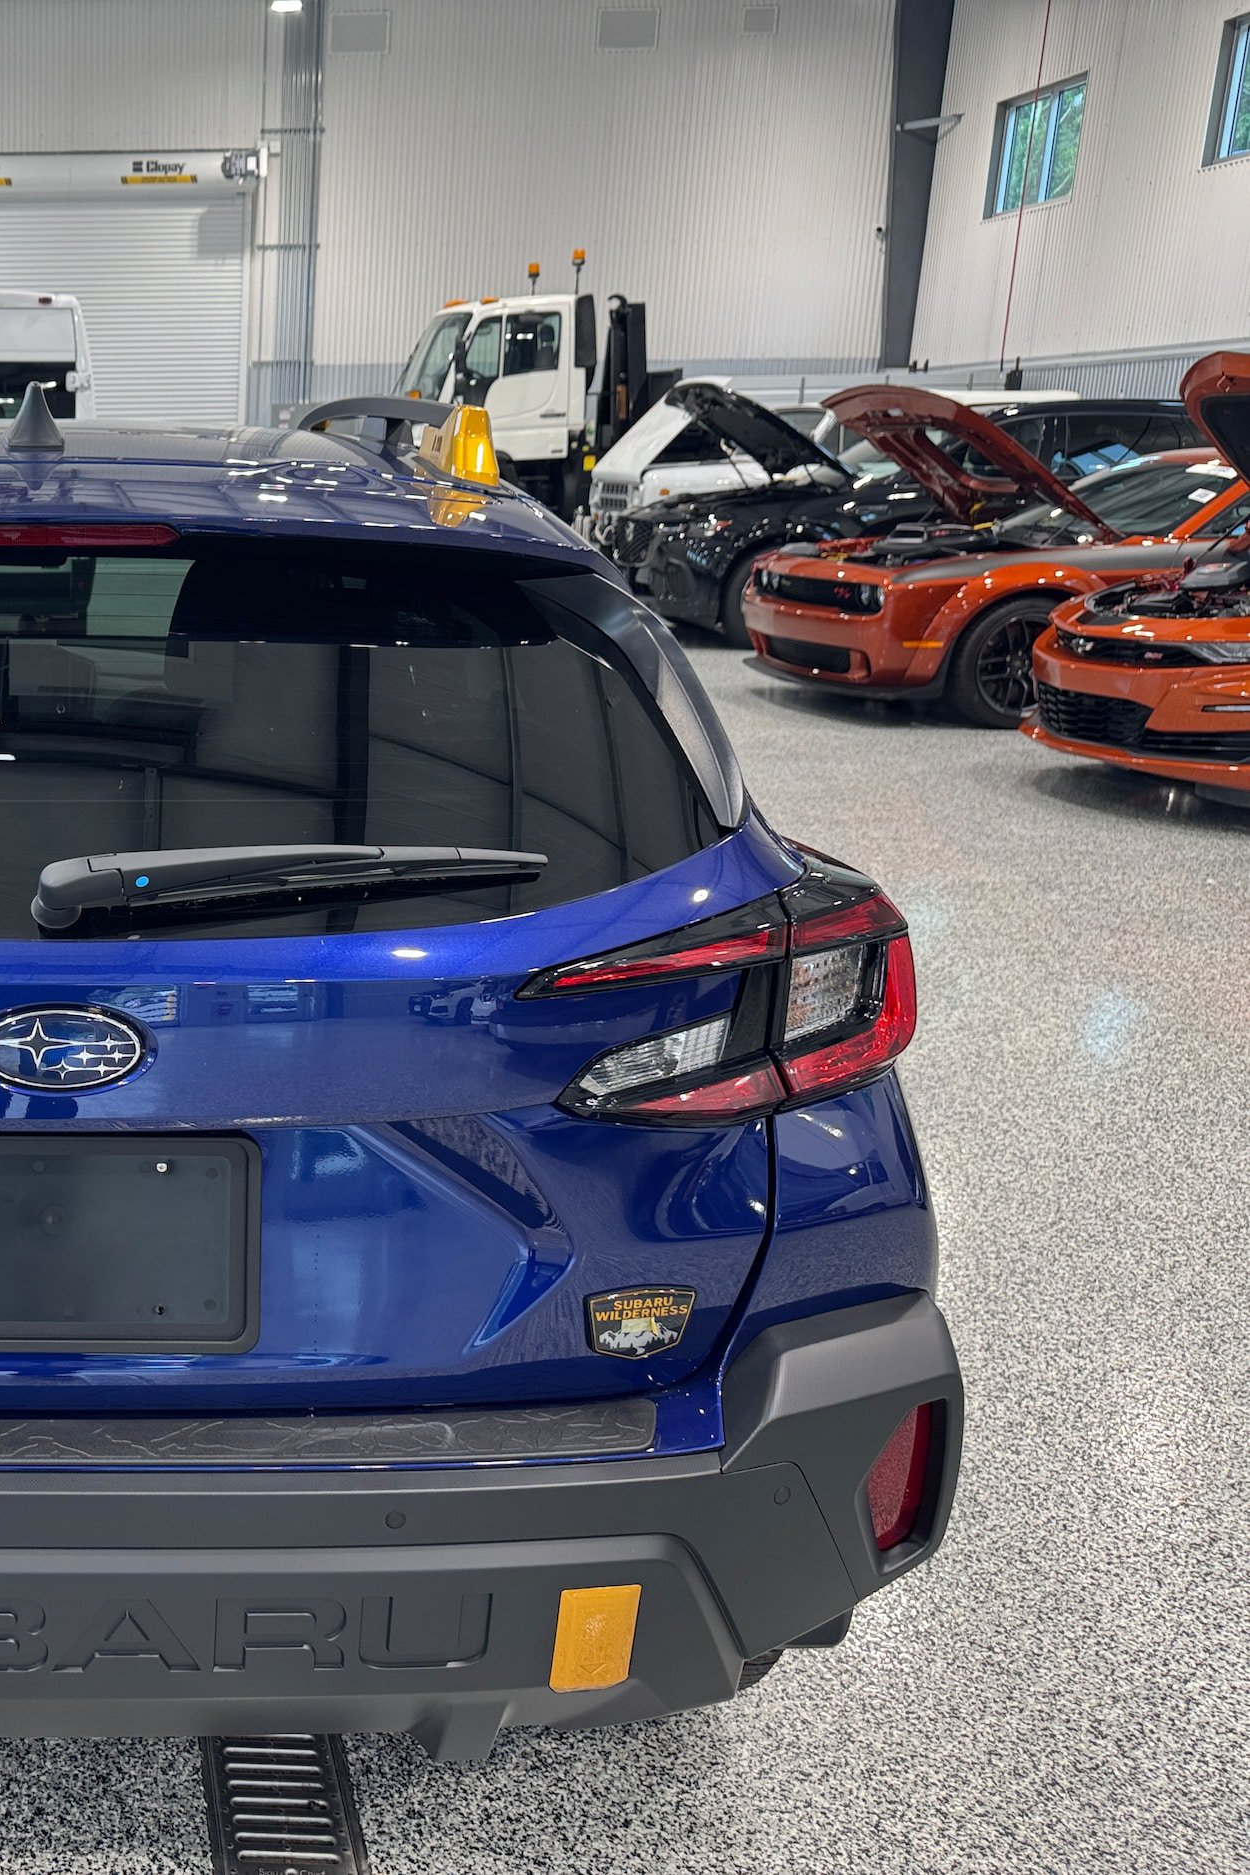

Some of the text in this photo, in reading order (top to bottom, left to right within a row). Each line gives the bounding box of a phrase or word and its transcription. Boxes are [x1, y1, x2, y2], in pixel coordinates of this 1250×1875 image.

[146, 160, 185, 174] Clopay
[613, 1296, 673, 1311] SUBARU
[595, 1304, 688, 1322] WILDERNESS
